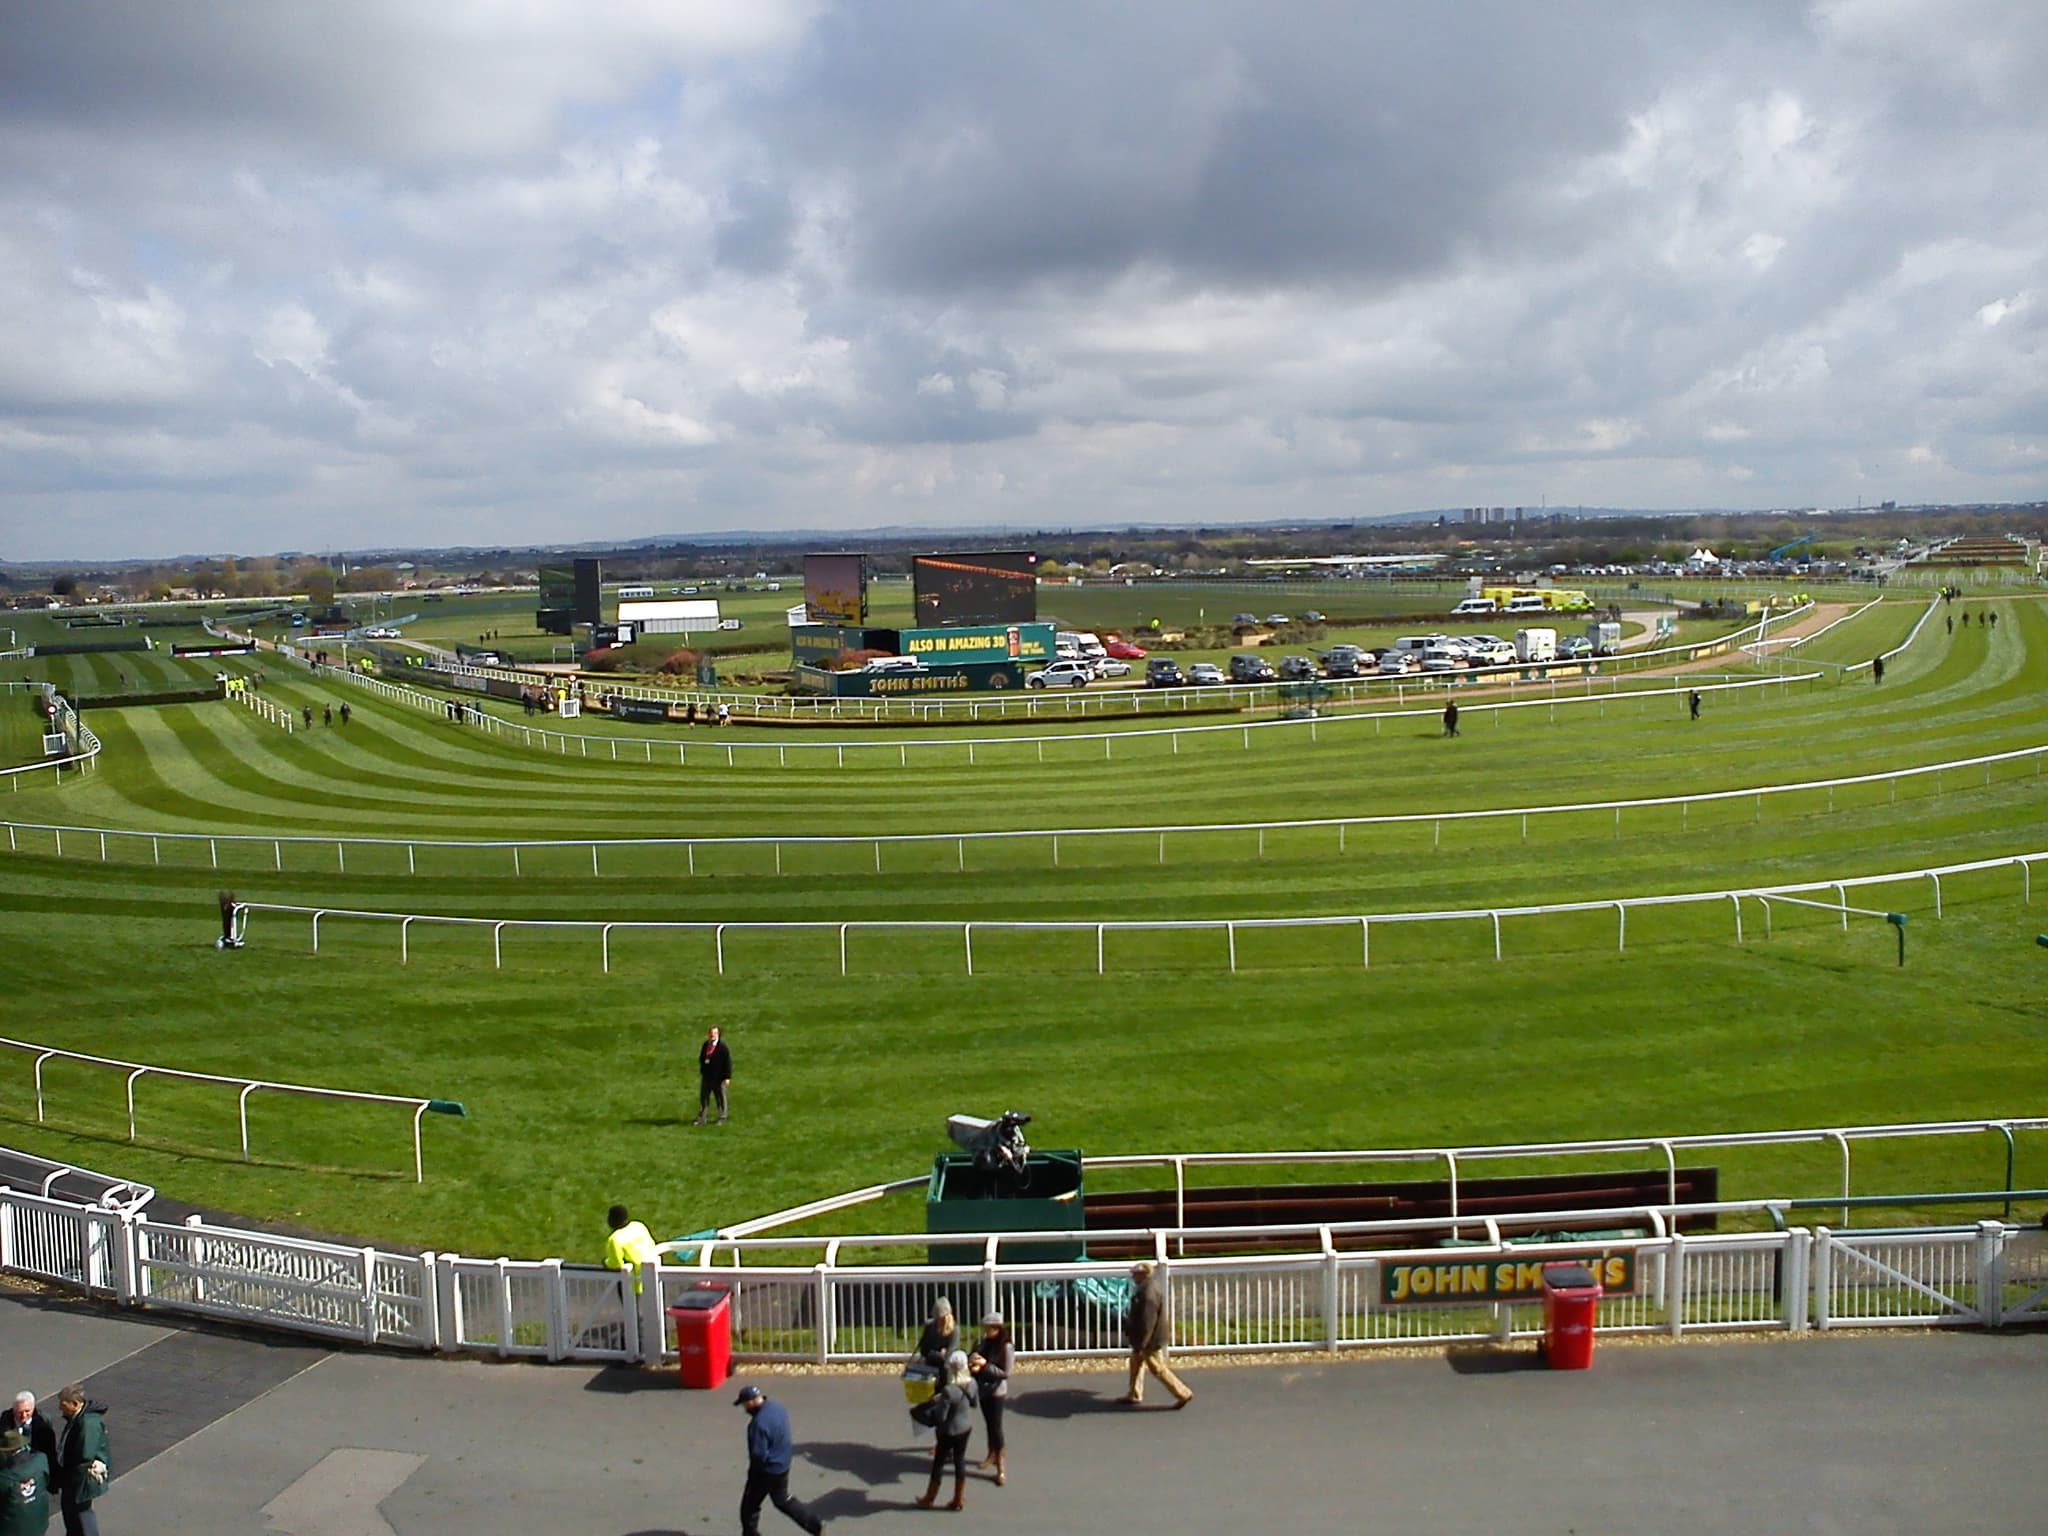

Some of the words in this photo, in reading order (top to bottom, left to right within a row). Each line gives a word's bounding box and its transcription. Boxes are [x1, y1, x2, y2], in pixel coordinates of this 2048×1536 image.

[909, 638, 934, 652] ALSO
[935, 637, 946, 651] IN
[948, 636, 991, 650] AMAZING
[992, 635, 1006, 648] 3D
[869, 678, 910, 693] JOHN
[912, 671, 969, 690] SMITH'S
[1391, 1264, 1489, 1301] JOHN
[1495, 1249, 1627, 1292] SMH'S
